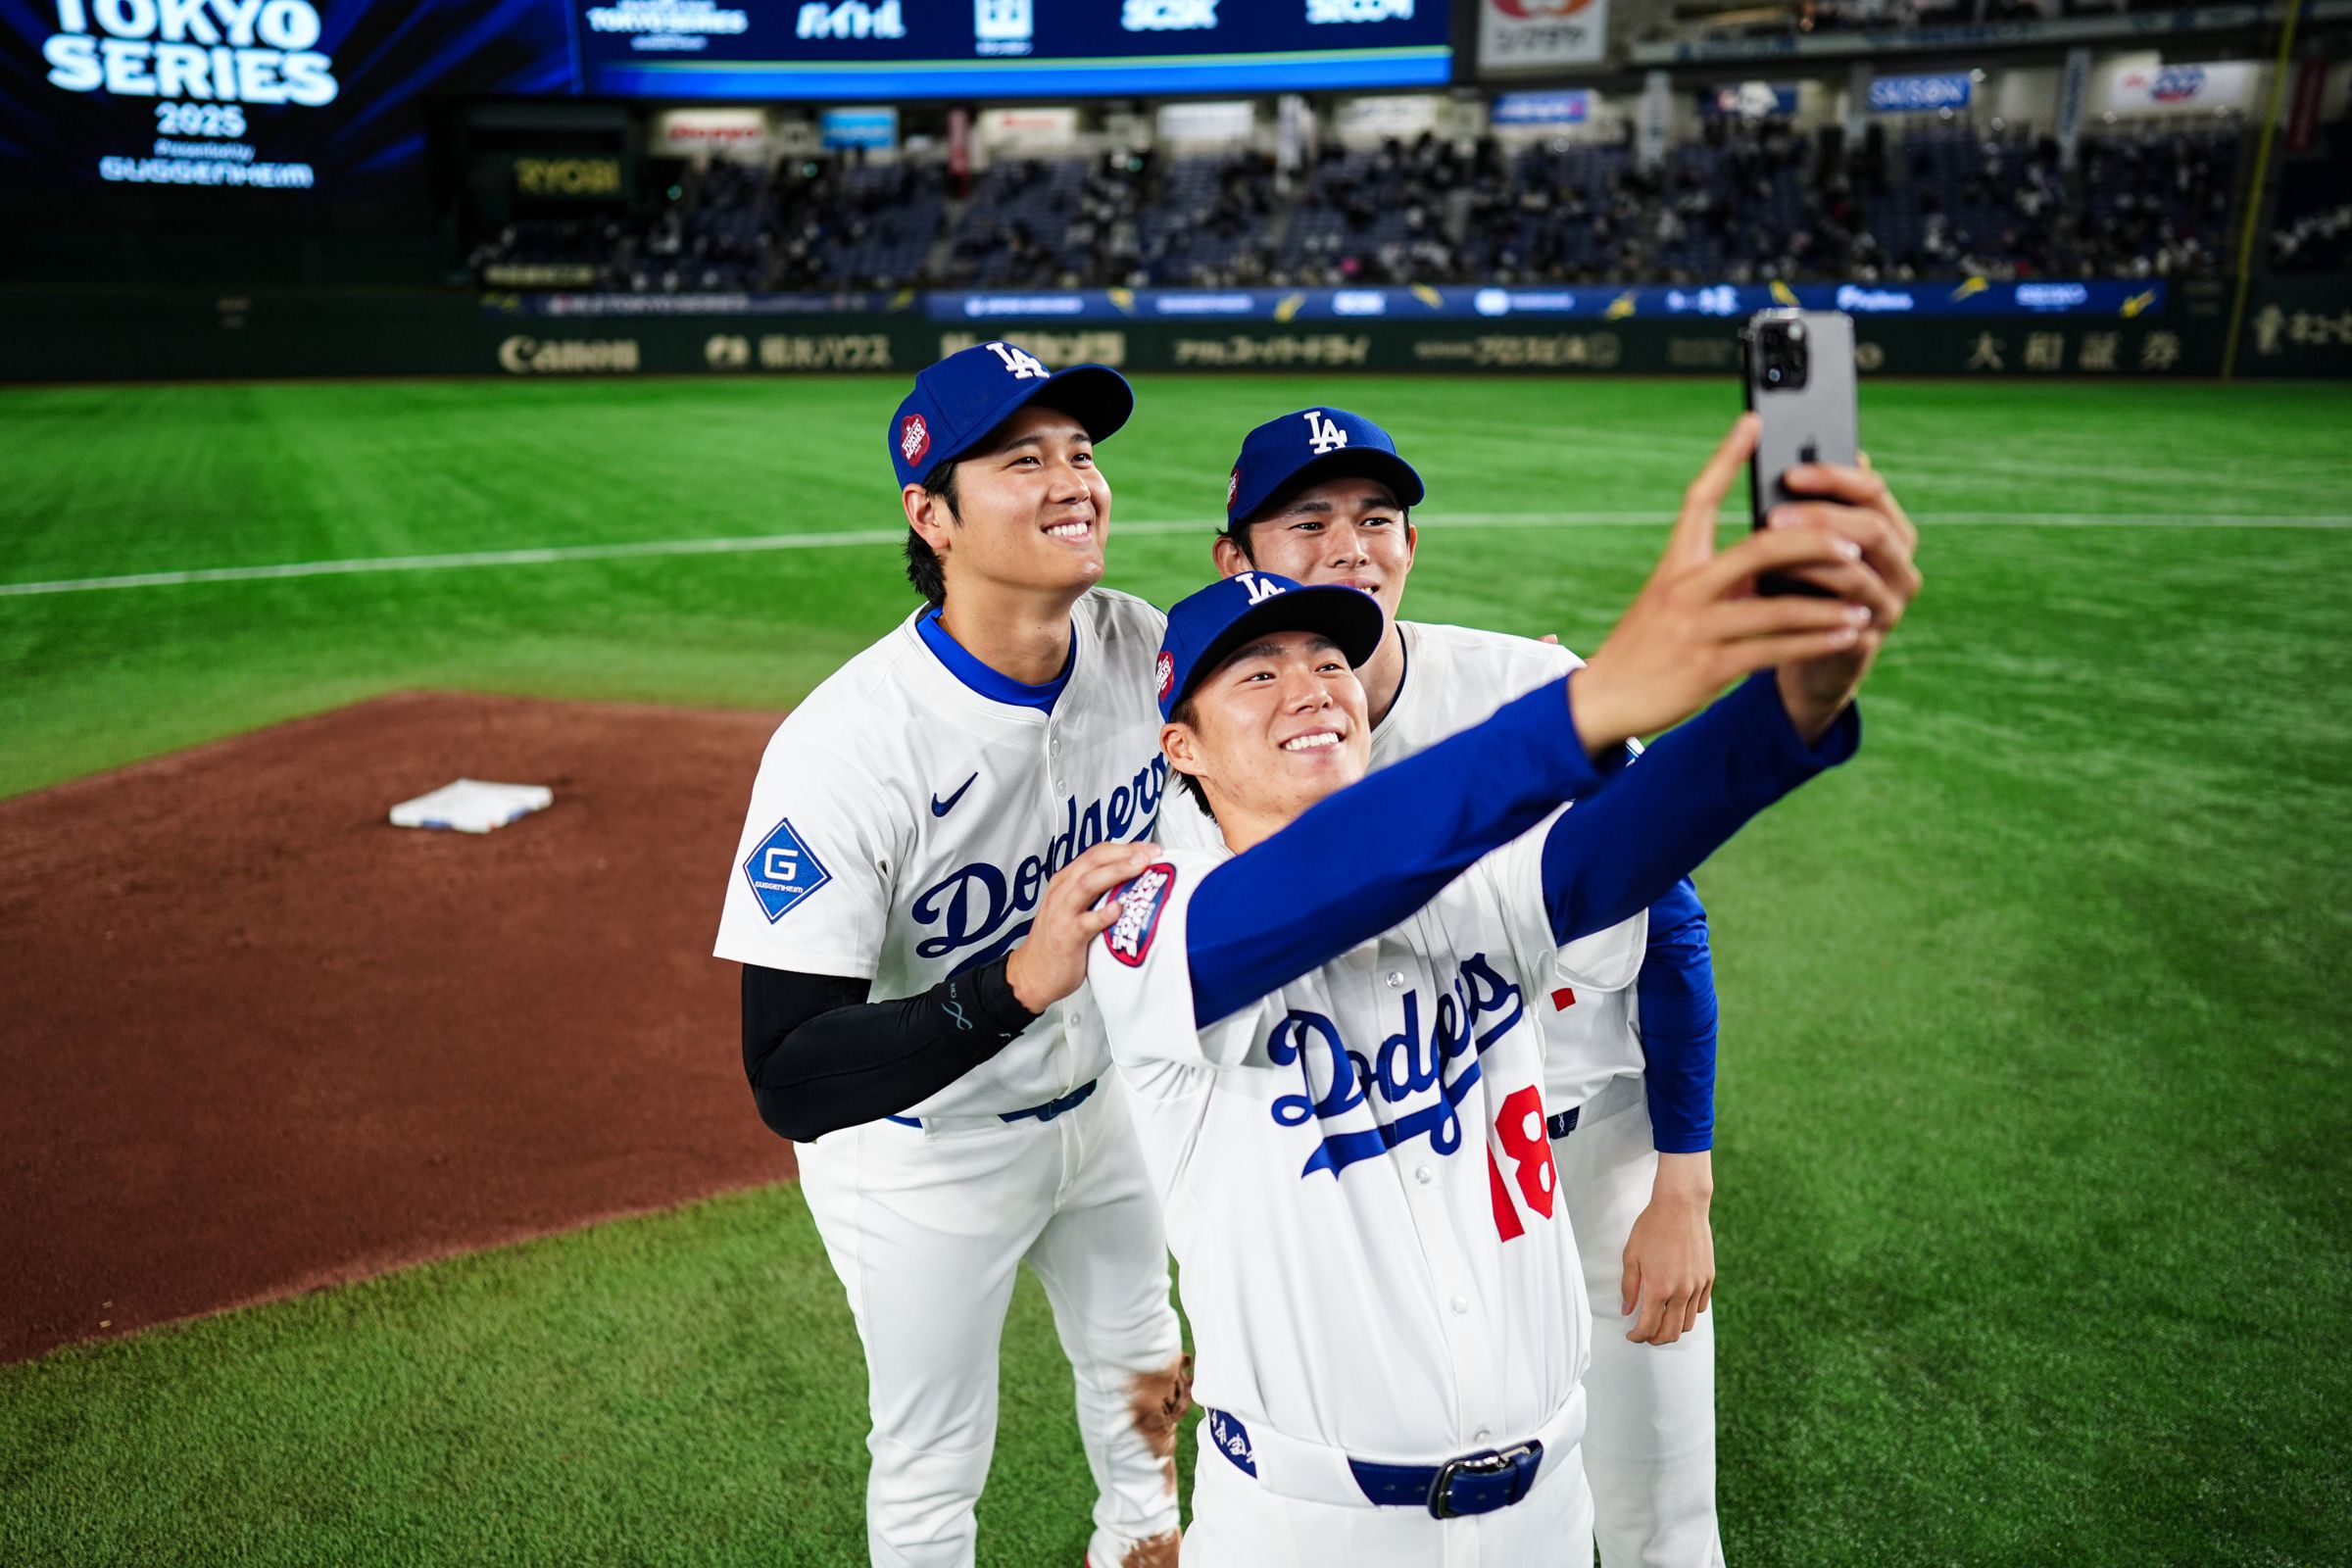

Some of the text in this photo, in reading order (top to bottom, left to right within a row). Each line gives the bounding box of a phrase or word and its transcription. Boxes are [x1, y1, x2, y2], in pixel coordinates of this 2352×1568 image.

[56, 0, 321, 49] TOKYO
[43, 33, 339, 107] SERIES
[1869, 76, 1964, 107] SAISON
[154, 102, 247, 138] 2025
[499, 335, 639, 372] Canon
[986, 342, 1051, 379] LA
[1303, 411, 1348, 455] LA
[764, 848, 799, 881] G
[755, 880, 804, 893] GUGGENHEIM
[1486, 1084, 1556, 1243] 18
